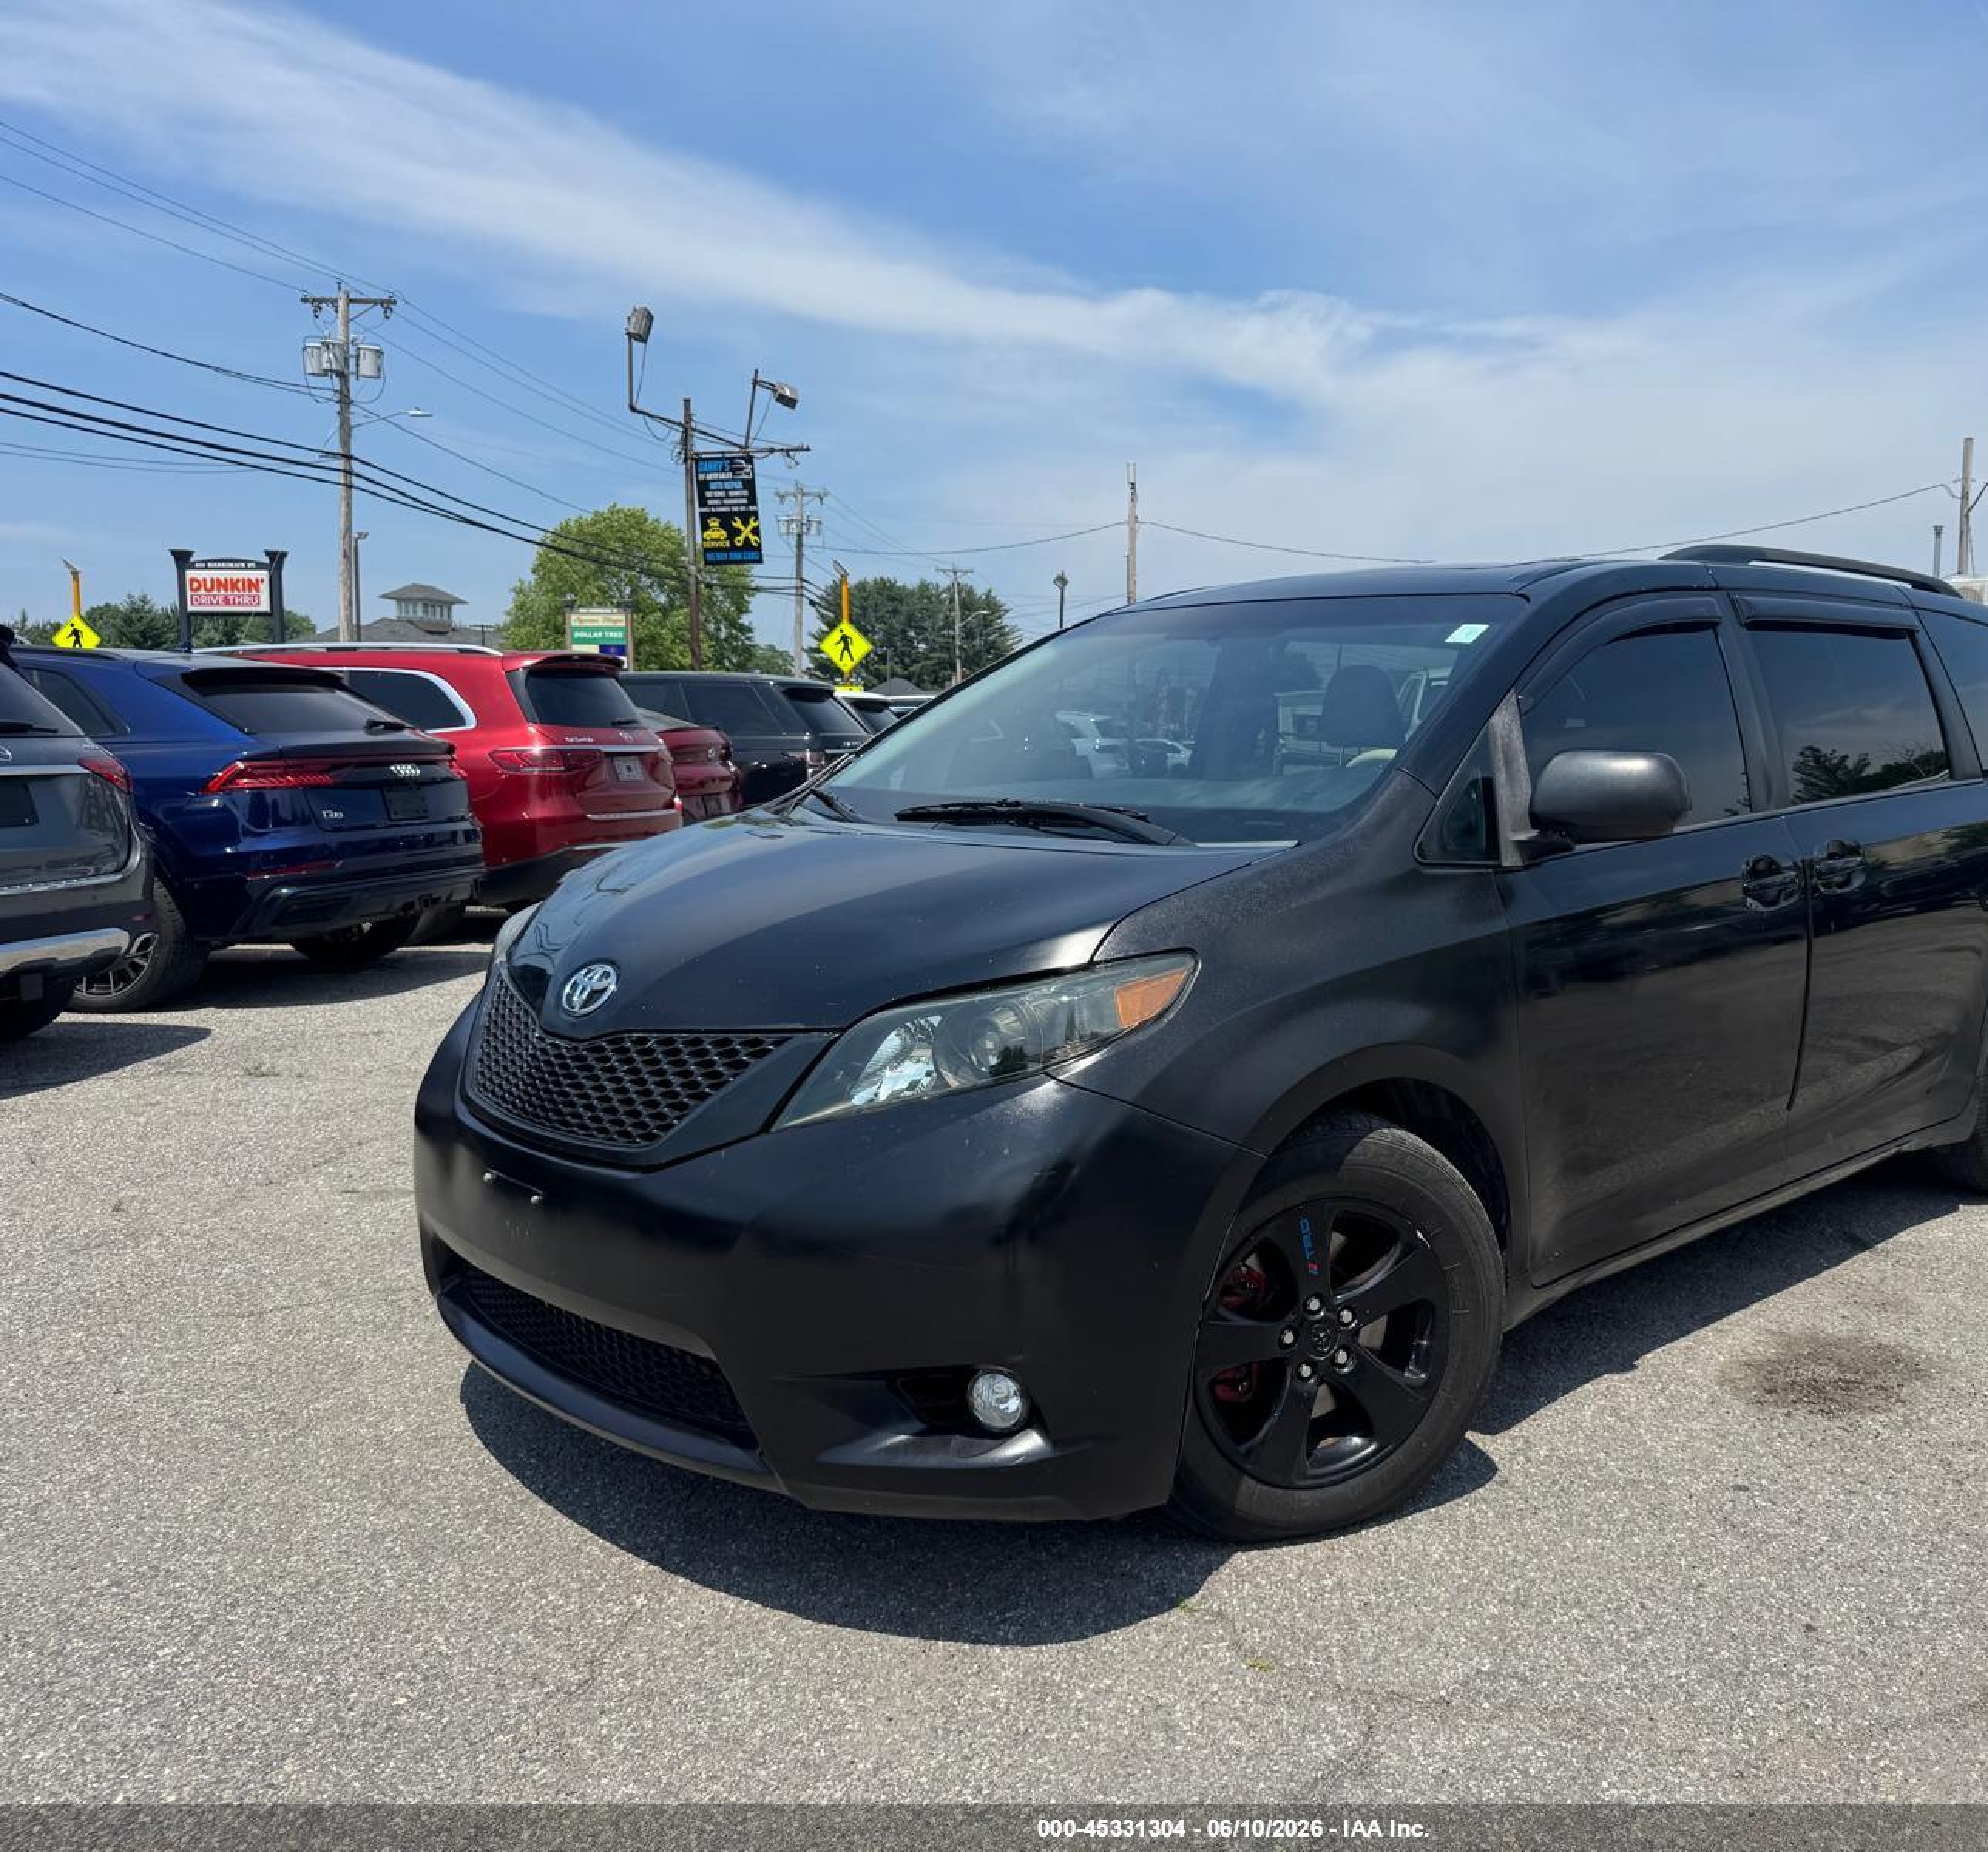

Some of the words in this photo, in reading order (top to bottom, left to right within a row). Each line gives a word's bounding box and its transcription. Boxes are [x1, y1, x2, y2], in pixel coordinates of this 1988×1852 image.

[189, 577, 264, 593] DUNKIN'
[193, 594, 225, 606] DRIVE
[229, 594, 259, 606] THRU
